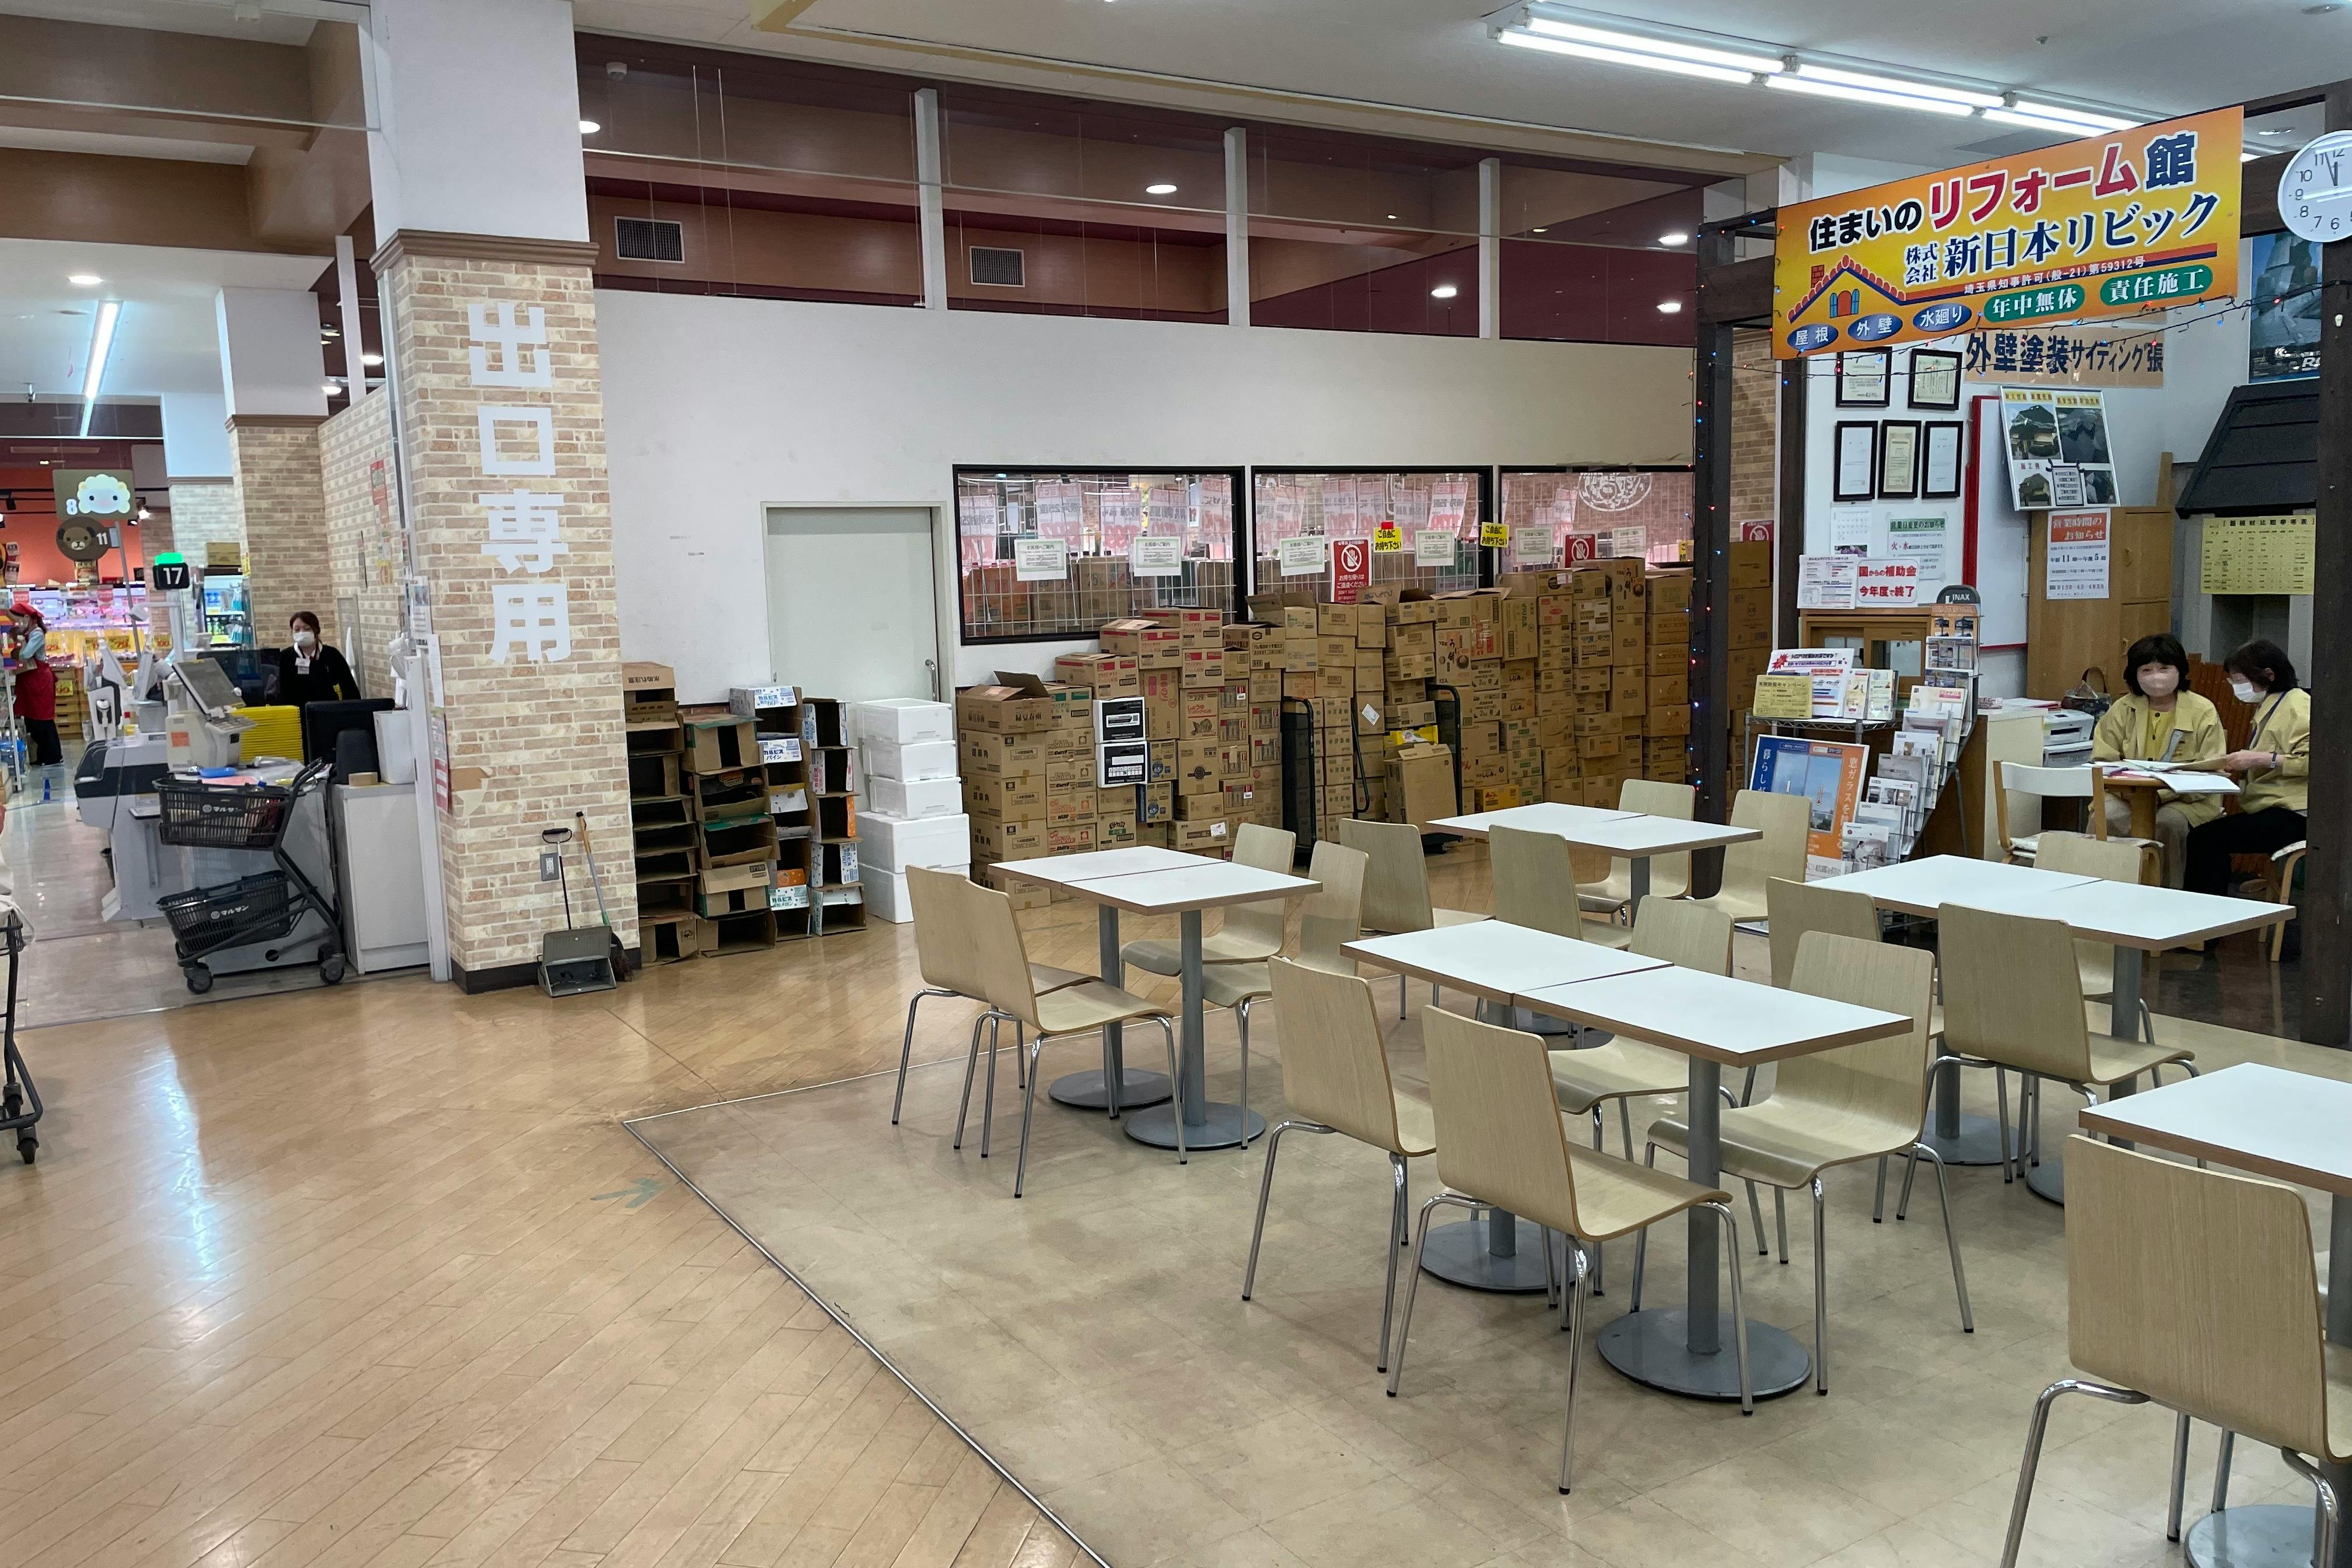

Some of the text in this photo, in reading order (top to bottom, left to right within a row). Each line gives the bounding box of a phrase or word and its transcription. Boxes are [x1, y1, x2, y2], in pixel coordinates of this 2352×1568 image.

[2300, 170, 2312, 182] 10
[1810, 131, 2197, 253] 住まいのリフォーム館
[2295, 188, 2304, 201] 9
[2300, 206, 2309, 218] 8
[2314, 215, 2322, 228] 7
[2330, 218, 2340, 230] 6
[1944, 192, 2218, 279] 新日本リビック
[2109, 270, 2204, 303] 責任施工
[1992, 287, 2078, 319] 年中無休
[1920, 306, 1963, 328] 水廻り
[1856, 316, 1893, 337] 外壁
[1795, 326, 1829, 346] 屋根
[467, 301, 572, 664] 出口専用
[66, 499, 78, 515] 8
[96, 533, 108, 545] 11
[163, 568, 183, 585] 17
